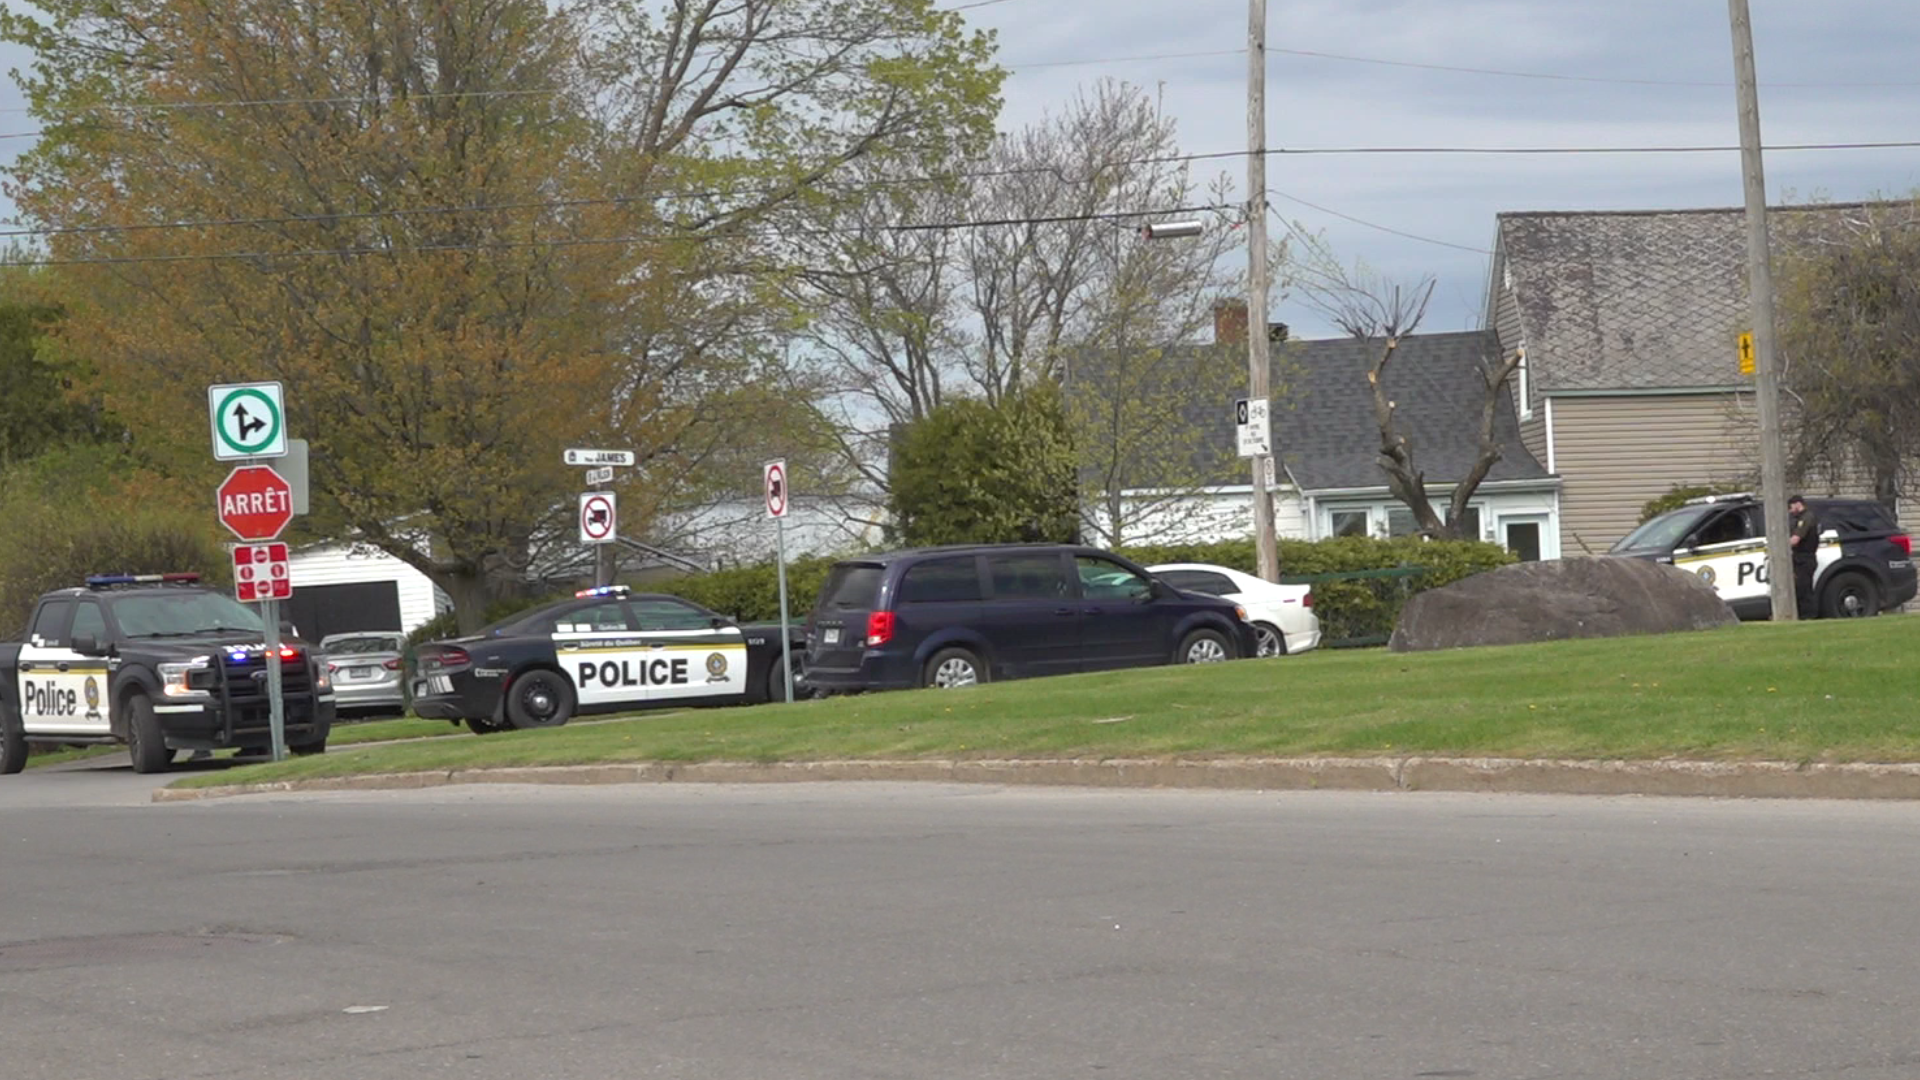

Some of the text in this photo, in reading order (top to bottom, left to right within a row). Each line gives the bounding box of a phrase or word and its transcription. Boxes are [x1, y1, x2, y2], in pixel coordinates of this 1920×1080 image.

[595, 452, 627, 464] JAMES
[223, 487, 287, 516] ARRÊT
[578, 658, 688, 688] POLICE
[25, 680, 77, 716] Police
